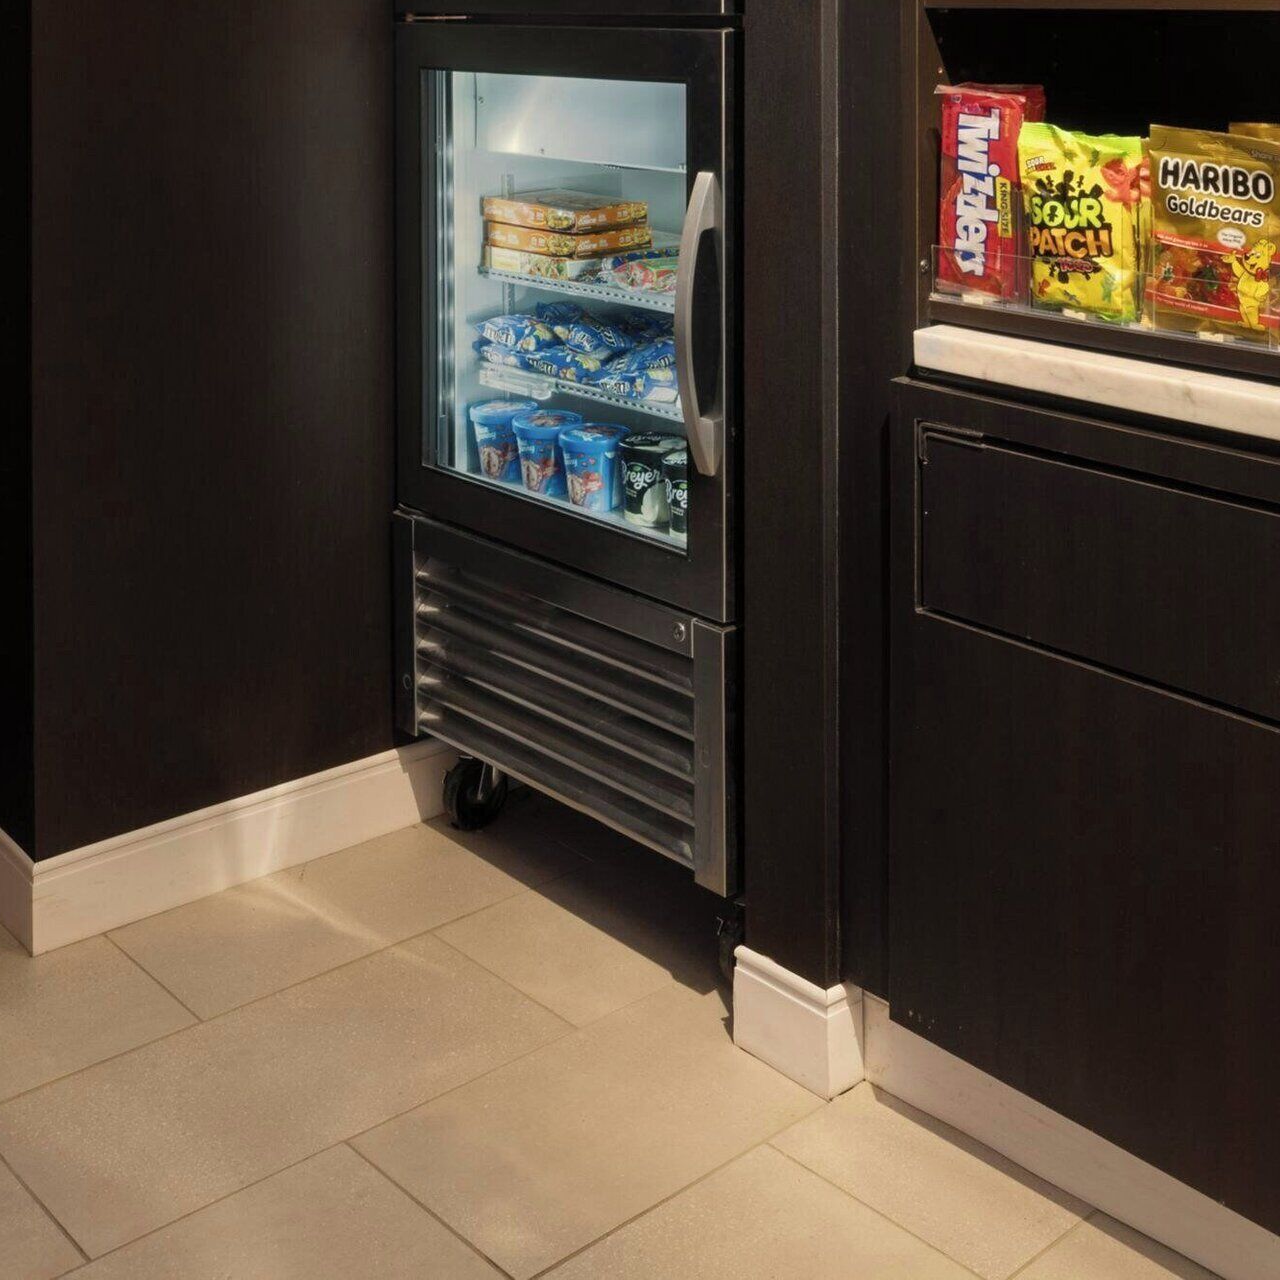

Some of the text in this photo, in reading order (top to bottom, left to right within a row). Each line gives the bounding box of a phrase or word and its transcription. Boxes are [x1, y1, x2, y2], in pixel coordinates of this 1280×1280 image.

[1160, 159, 1274, 202] HARIBO
[1000, 182, 1010, 233] KING SIZE
[1031, 196, 1104, 230] SOUR
[1167, 195, 1264, 226] Goldbears
[1030, 225, 1113, 258] PATCH
